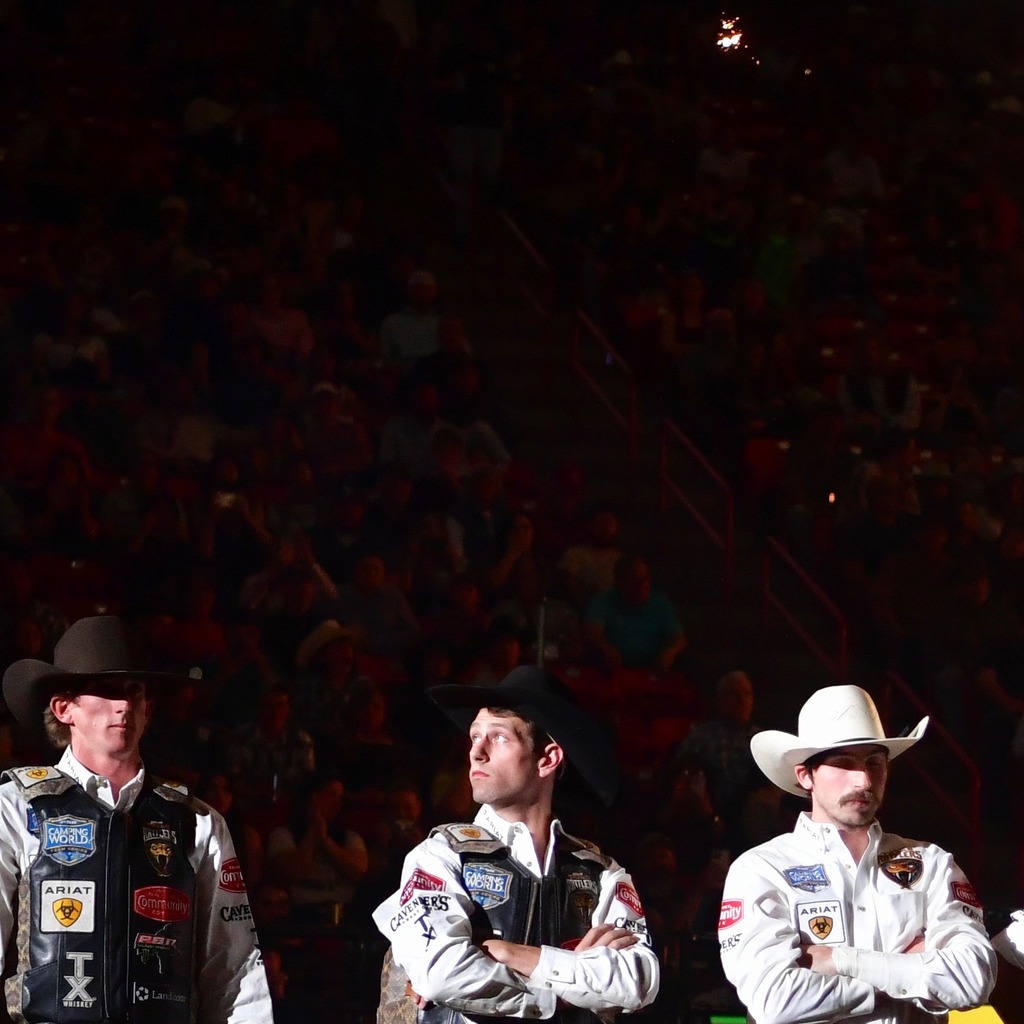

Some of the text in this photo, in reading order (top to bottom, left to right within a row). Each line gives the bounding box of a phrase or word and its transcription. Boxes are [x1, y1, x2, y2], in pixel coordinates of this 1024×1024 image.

[48, 828, 88, 836] CAMPING
[49, 835, 88, 844] WORLD
[466, 871, 504, 885] CAMPING
[44, 886, 92, 895] ARIAT
[466, 877, 503, 892] WORLD
[137, 895, 188, 914] Community
[800, 905, 838, 915] ARIAT
[390, 894, 451, 932] CAVENDER'S
